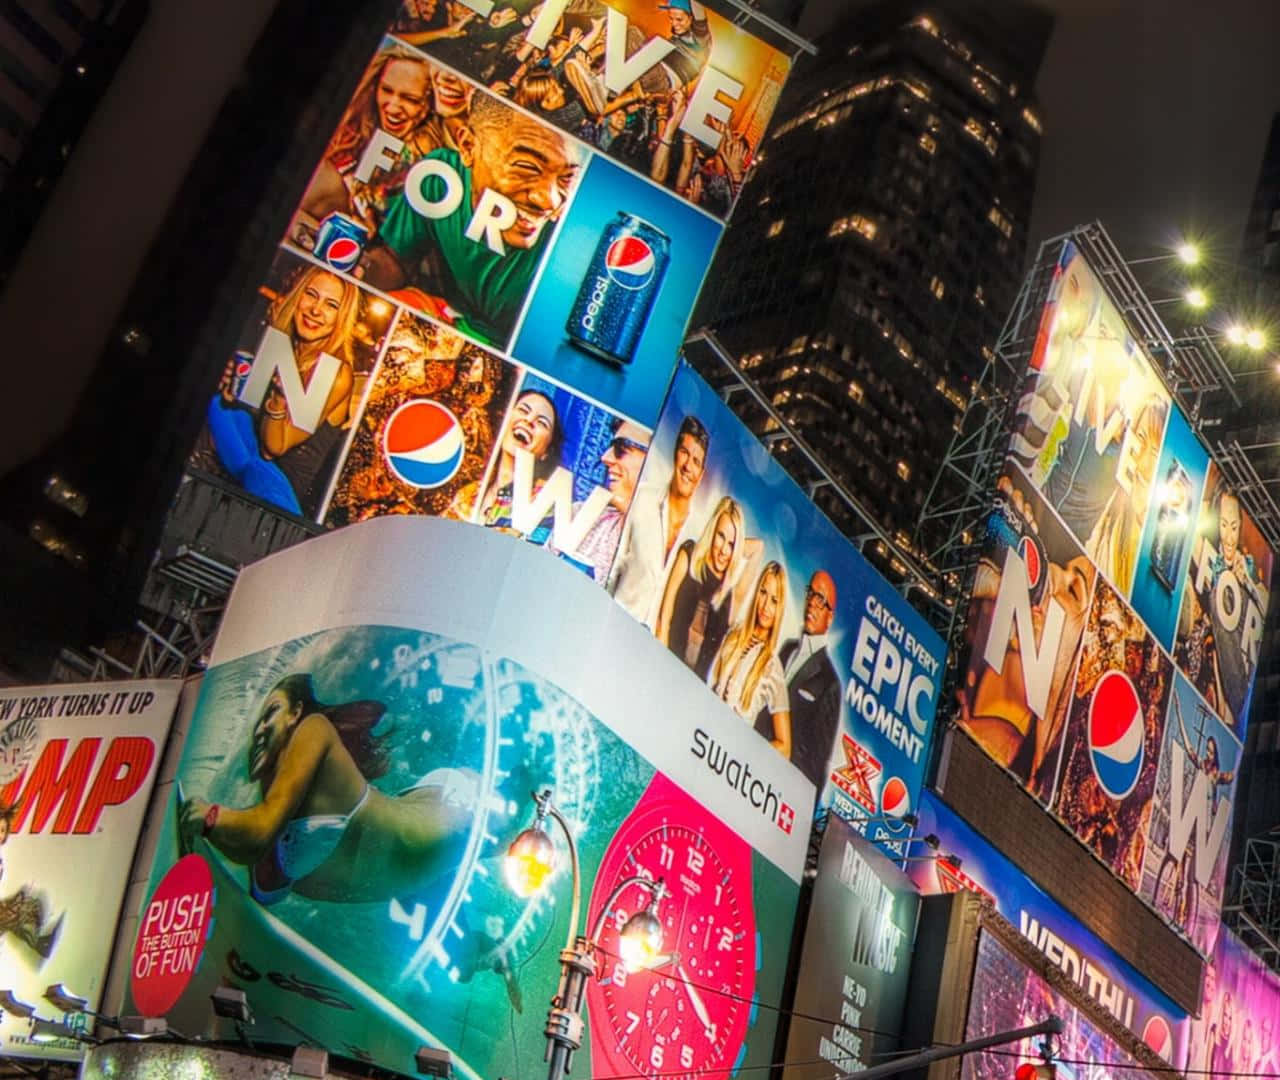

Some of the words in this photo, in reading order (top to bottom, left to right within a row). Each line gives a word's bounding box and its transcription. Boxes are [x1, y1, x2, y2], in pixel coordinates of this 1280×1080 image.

[462, 0, 744, 150] IVE
[354, 129, 516, 257] FOR
[580, 275, 609, 333] pepsi
[866, 595, 904, 643] CATCH
[905, 634, 940, 676] EVERY
[1196, 540, 1262, 666] FOR
[18, 695, 59, 719] YORK
[59, 692, 110, 717] TURNS
[109, 691, 130, 715] IT
[129, 691, 154, 714] UP
[851, 616, 934, 737] EPIC
[846, 678, 923, 763] MOMENT
[690, 728, 780, 822] swatch
[142, 936, 161, 953] THE
[160, 928, 201, 950] BUTTON
[144, 892, 210, 936] PUSH
[136, 951, 160, 979] OF
[160, 945, 197, 976] FUN
